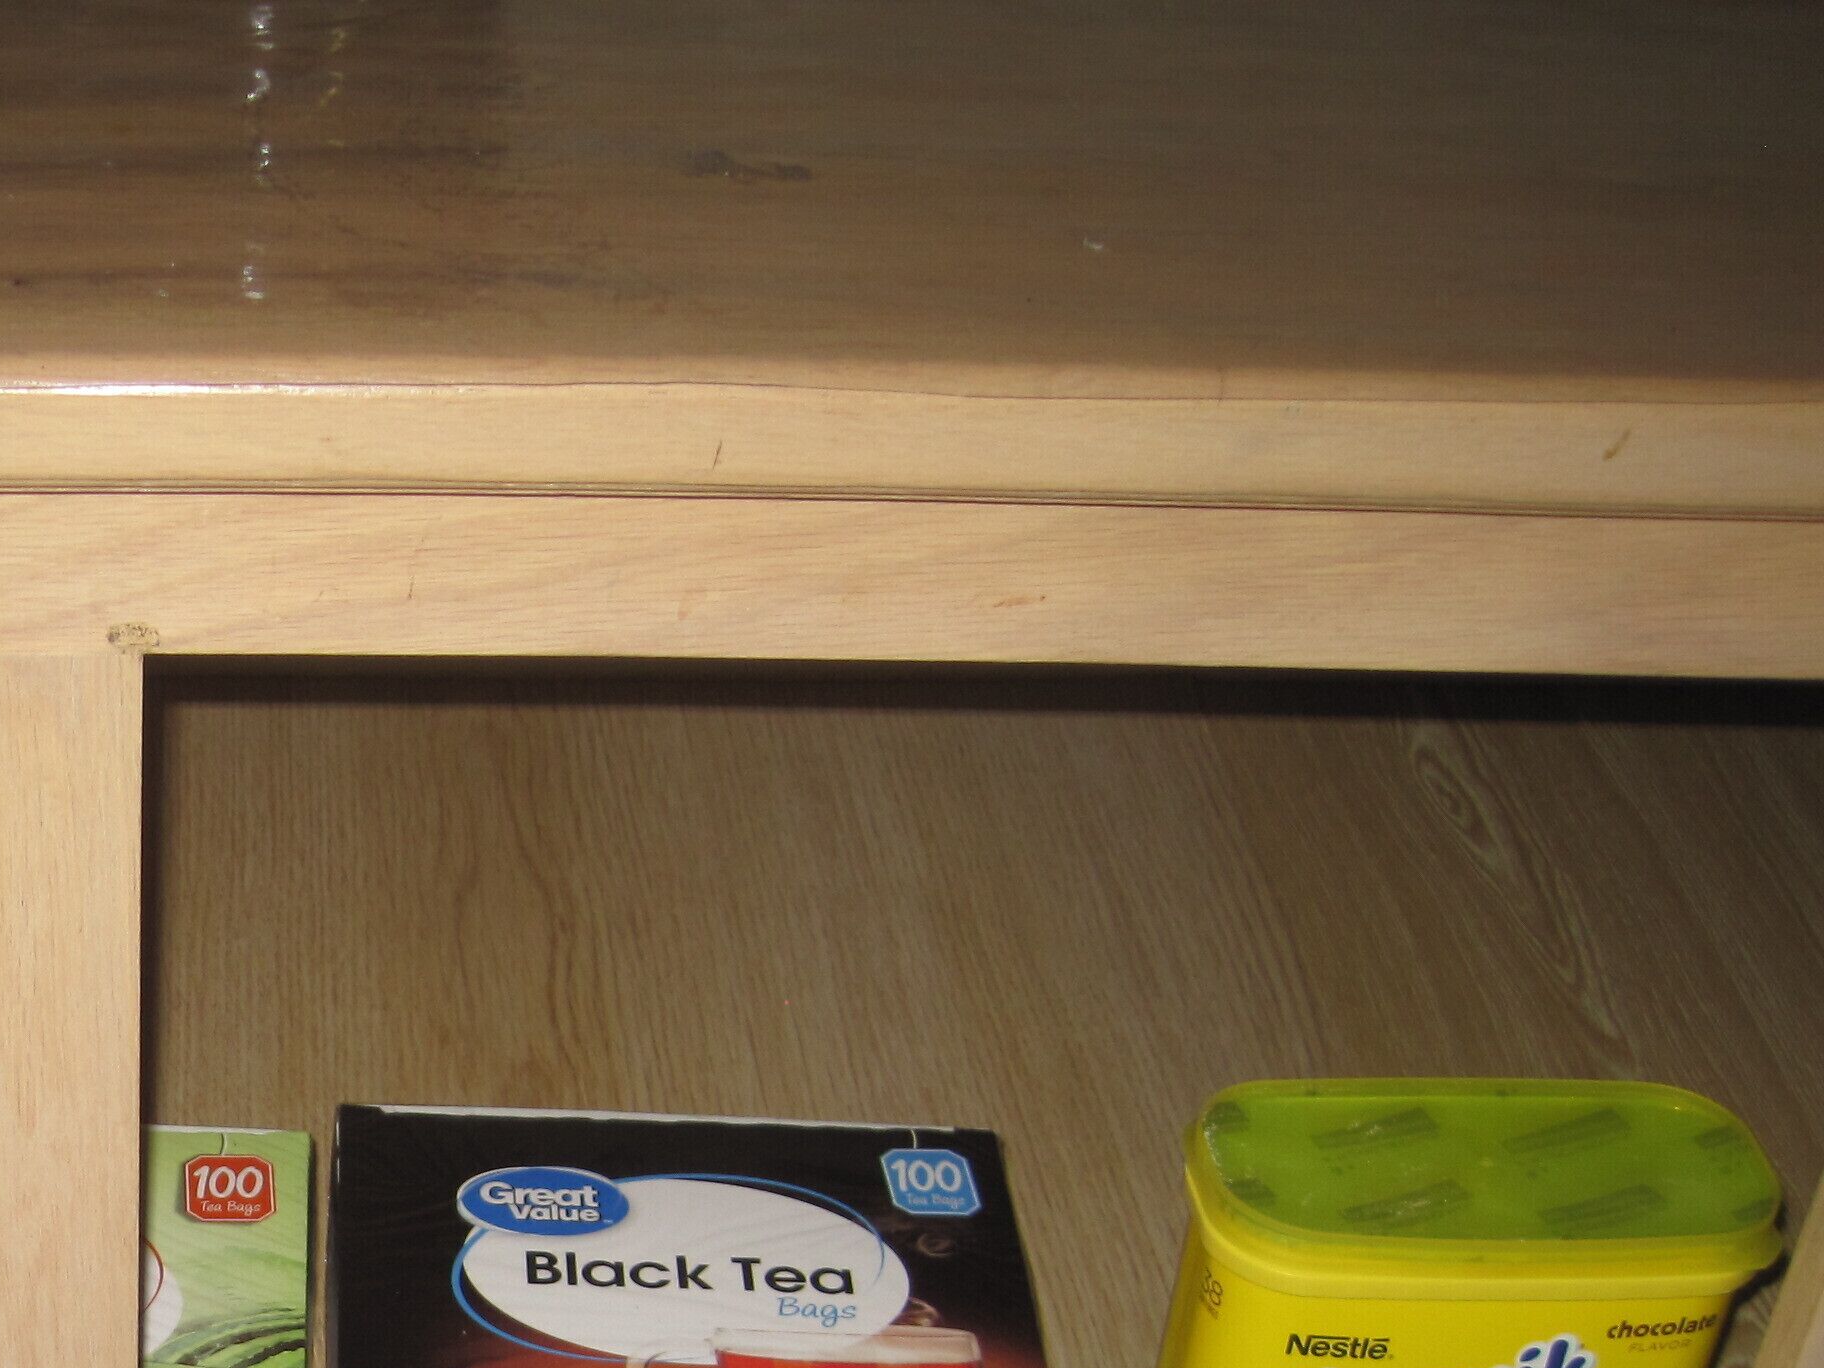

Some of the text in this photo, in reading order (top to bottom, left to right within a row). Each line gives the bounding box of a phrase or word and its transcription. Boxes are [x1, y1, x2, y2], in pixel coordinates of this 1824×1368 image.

[193, 1165, 264, 1199] 100
[891, 1159, 962, 1192] 100
[480, 1181, 599, 1207] Great
[201, 1200, 261, 1216] Tea Bags
[511, 1203, 601, 1222] Value
[525, 1249, 854, 1295] Black Tea
[777, 1297, 858, 1328] Bags
[1606, 1313, 1718, 1339] chocolate
[1628, 1338, 1693, 1352] FLAVOR
